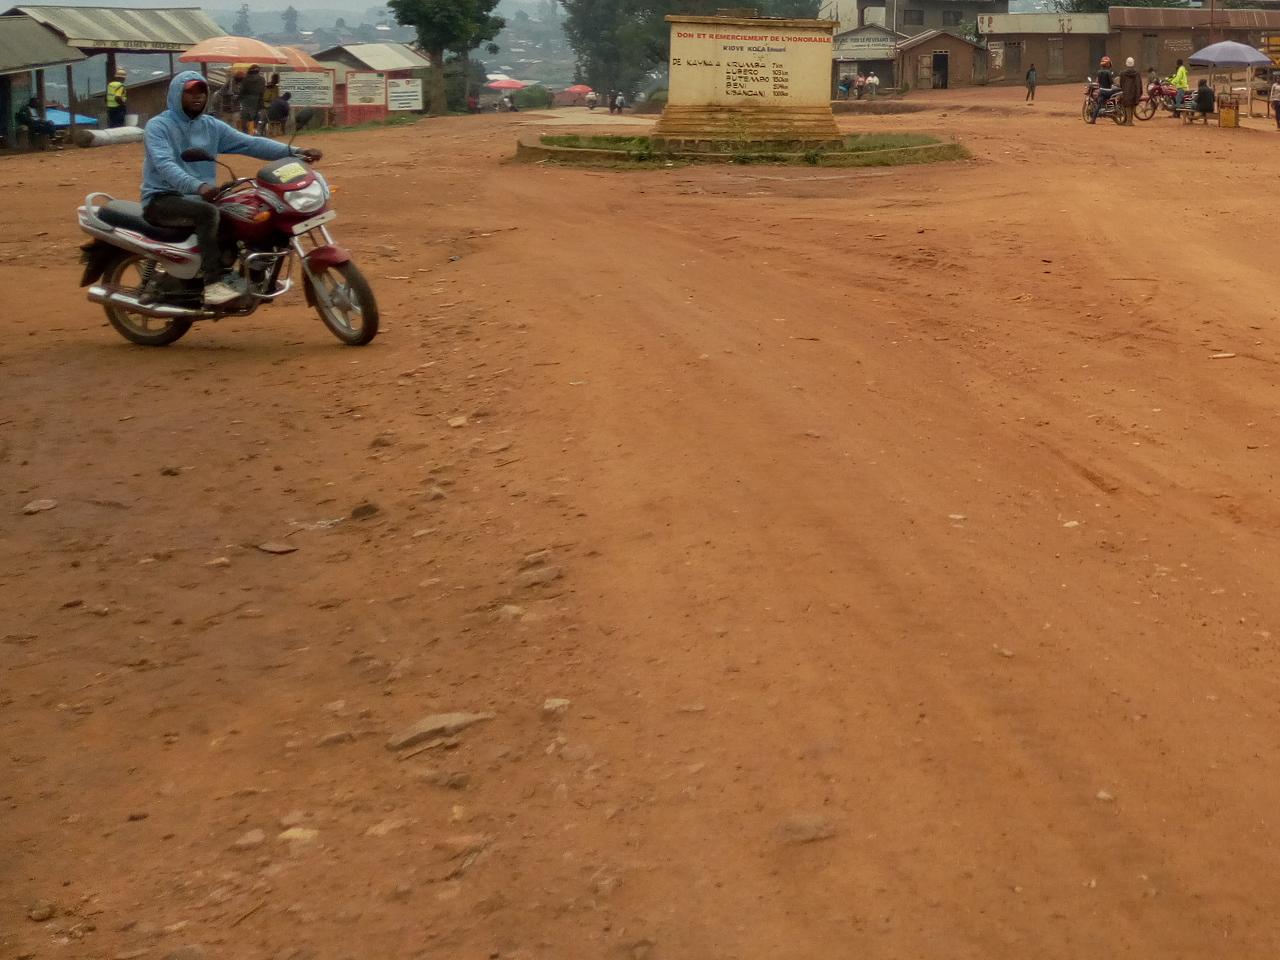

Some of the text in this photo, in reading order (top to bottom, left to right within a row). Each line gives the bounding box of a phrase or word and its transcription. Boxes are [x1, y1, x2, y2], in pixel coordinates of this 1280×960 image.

[709, 33, 769, 42] REMERCIEMENT
[781, 35, 832, 43] L'HONORABLE
[673, 58, 681, 66] DE
